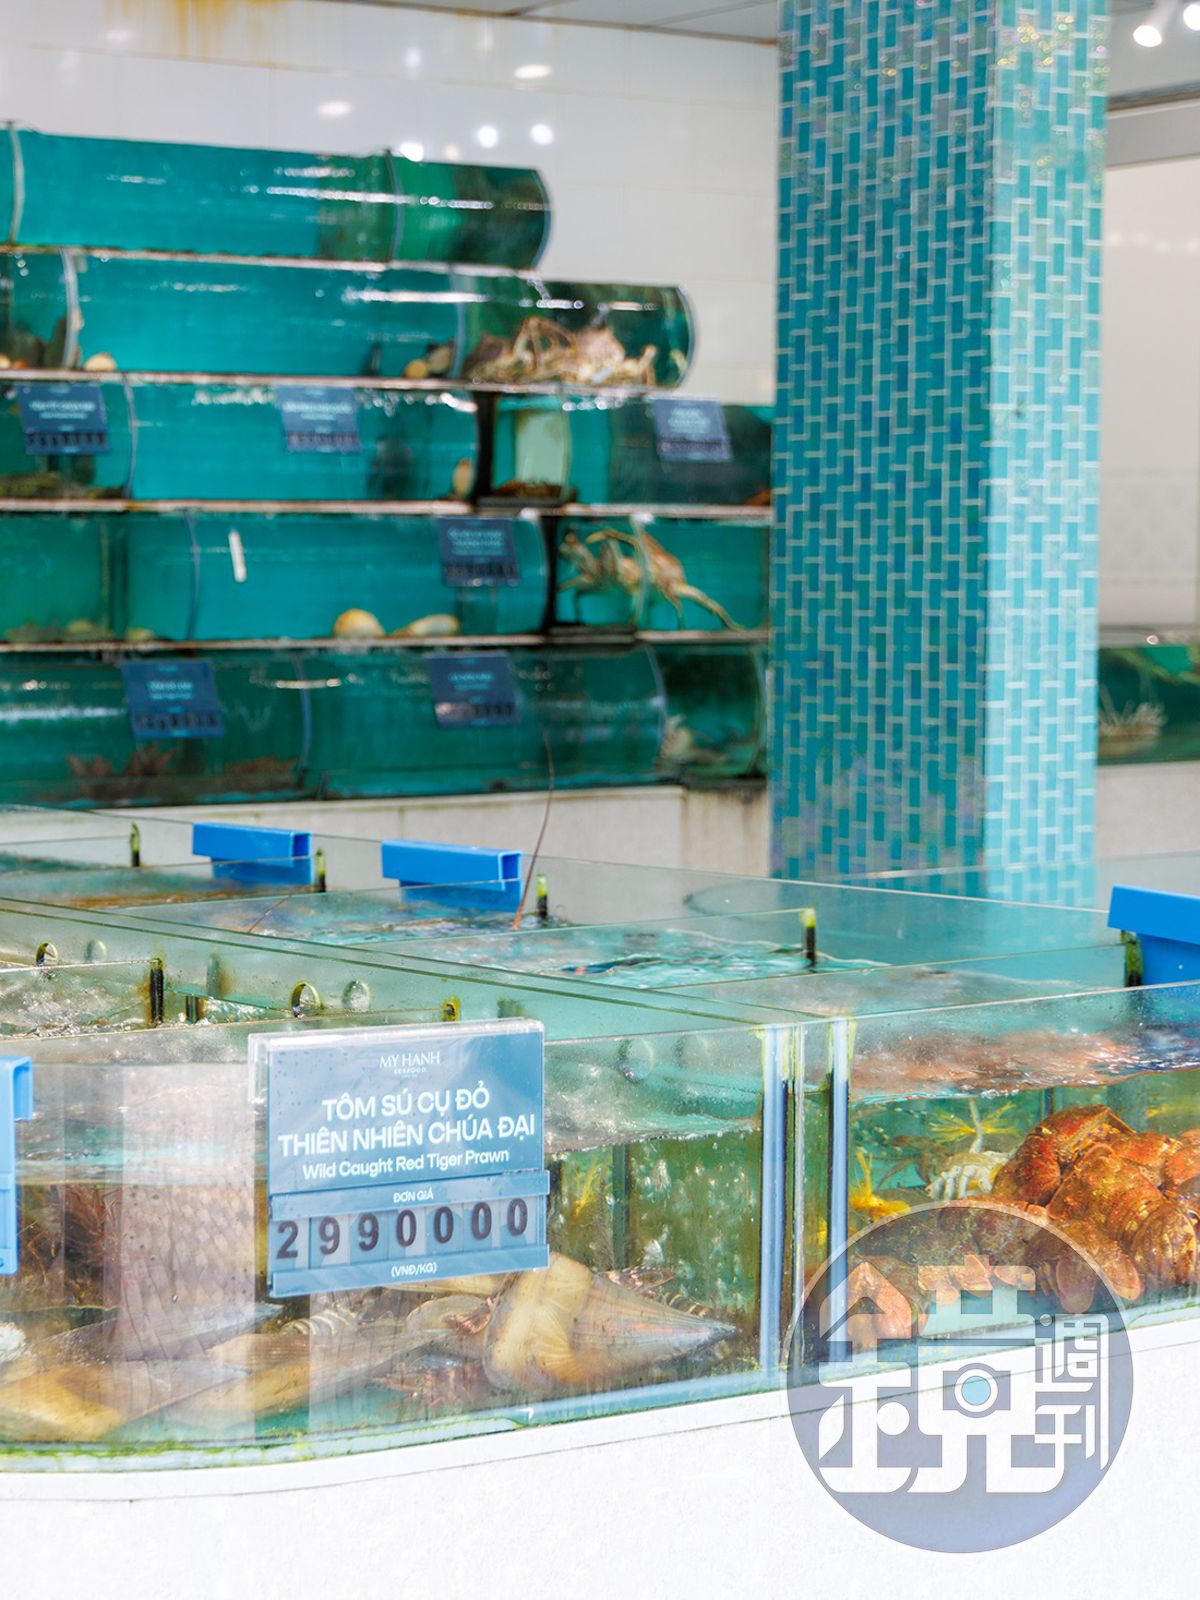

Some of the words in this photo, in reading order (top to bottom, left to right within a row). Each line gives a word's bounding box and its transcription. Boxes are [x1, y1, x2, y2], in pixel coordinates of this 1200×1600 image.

[322, 1092, 376, 1122] TÔM
[380, 1087, 413, 1117] SÚ
[417, 1089, 450, 1120] CỤ
[455, 1080, 491, 1111] ĐỎ
[277, 1126, 348, 1158] THIÊN
[352, 1119, 424, 1151] NHIÊN
[427, 1113, 493, 1143] CHÚA
[497, 1112, 536, 1142] ĐẠI
[302, 1162, 336, 1180] Wild
[338, 1157, 394, 1177] Caught
[396, 1154, 424, 1172] Red
[426, 1151, 463, 1171] Tiger
[465, 1148, 510, 1166] Prawn
[276, 1198, 529, 1260] 2990000
